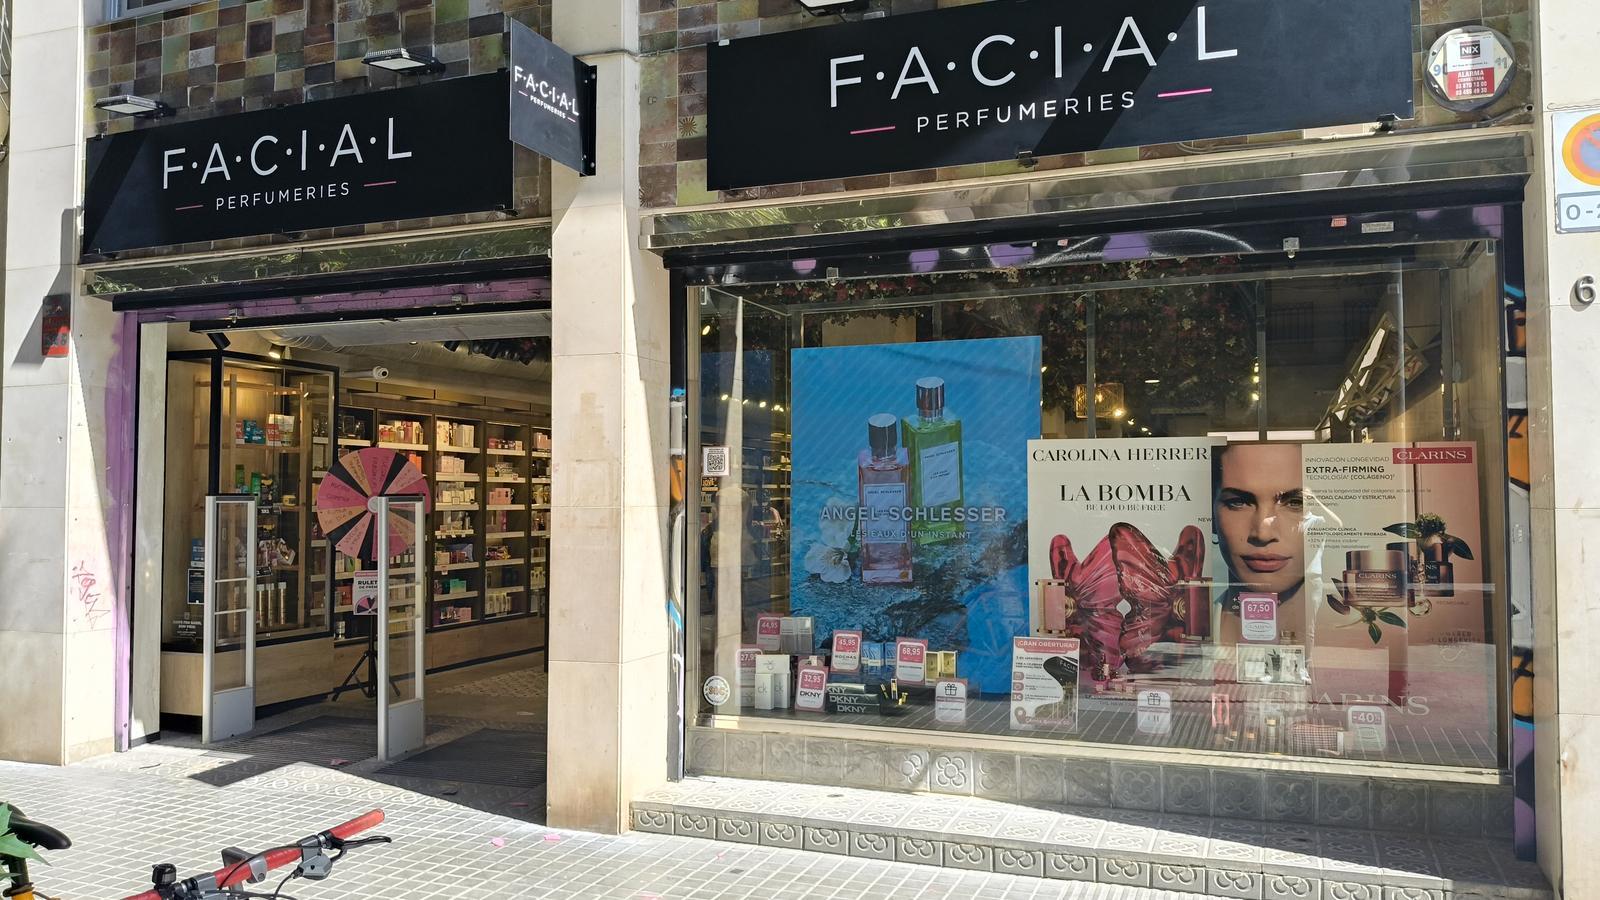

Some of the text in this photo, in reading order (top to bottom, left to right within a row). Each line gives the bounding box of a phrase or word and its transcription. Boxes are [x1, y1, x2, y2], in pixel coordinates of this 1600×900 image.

[1461, 45, 1479, 55] NIX
[1458, 70, 1484, 78] ALARMA
[530, 95, 566, 119] PERFUMERIES
[917, 91, 1135, 133] PERFUMERIES
[216, 182, 350, 210] PERFUMERIES
[1565, 203, 1600, 221] 0-
[1574, 275, 1597, 305] 6
[1033, 447, 1211, 462] CAROLINA HERRER
[1396, 450, 1467, 461] CLARINS
[1305, 465, 1385, 474] EXTRA-FIRMING
[1060, 484, 1192, 502] LA BOMBA
[820, 506, 881, 521] ANGEL
[889, 506, 1006, 522] SCHLESSER
[850, 530, 972, 539] LES EAUX D'UN INSTANT
[1247, 604, 1270, 613] 67,50
[902, 647, 921, 656] 68,95
[803, 674, 821, 683] 32,95
[799, 690, 822, 698] DKNY
[829, 695, 859, 704] DKNY
[1267, 689, 1430, 716] CARINS
[837, 704, 867, 713] DKNY
